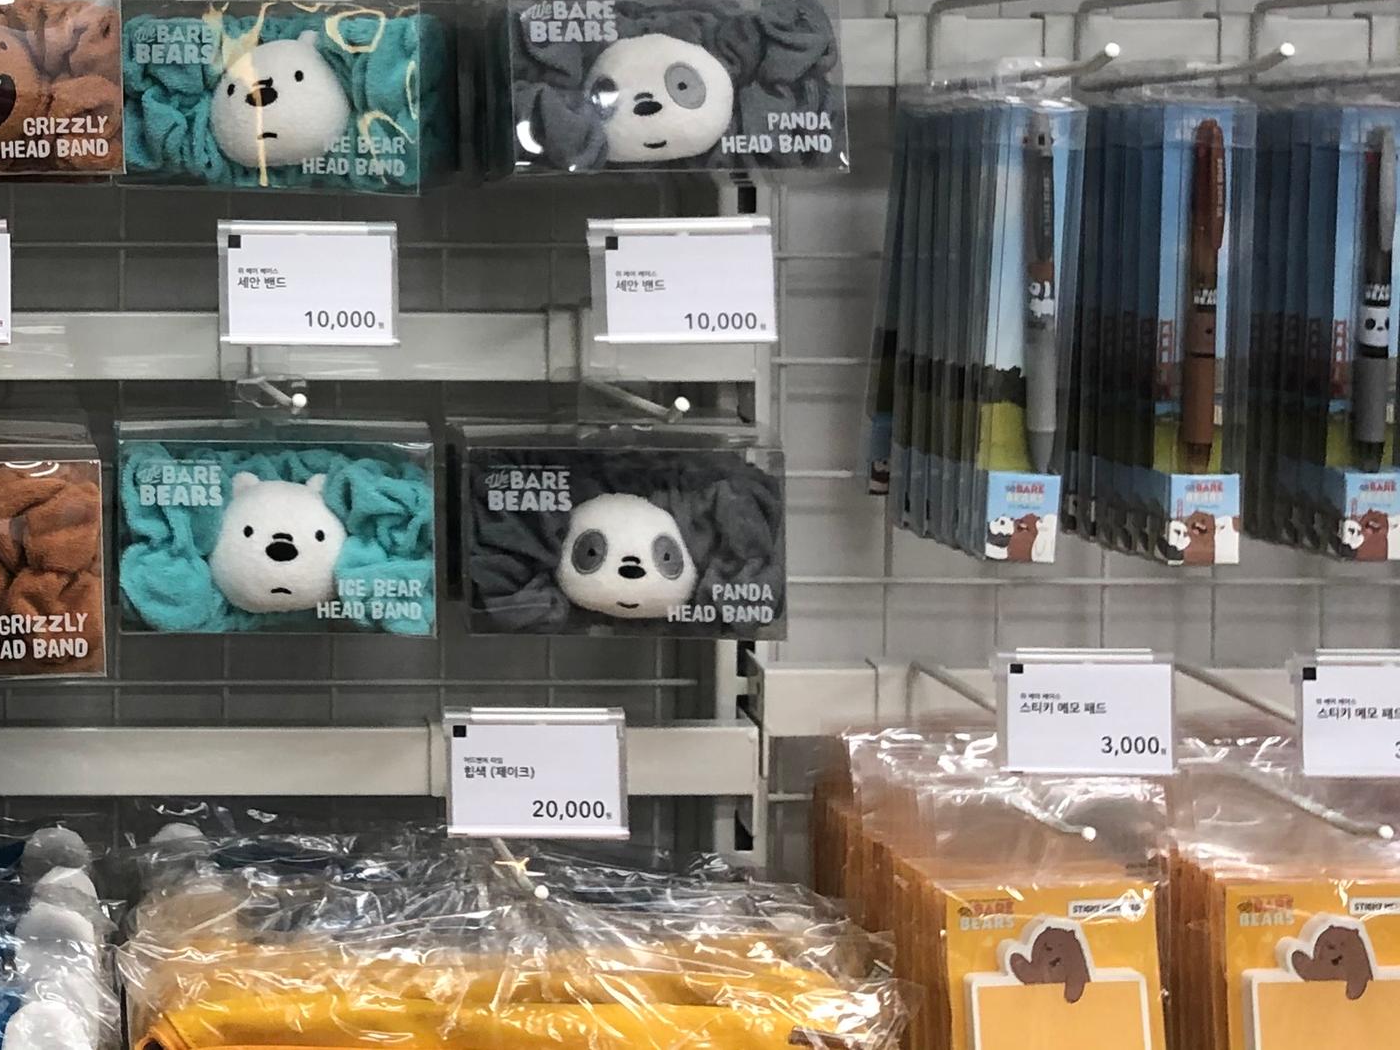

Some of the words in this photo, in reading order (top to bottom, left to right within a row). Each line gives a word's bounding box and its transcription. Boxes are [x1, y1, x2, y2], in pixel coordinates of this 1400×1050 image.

[552, 0, 615, 20] BARE
[530, 20, 618, 42] BEARS
[135, 45, 214, 64] BEARS
[23, 115, 108, 136] GRIZZLY
[768, 112, 832, 130] PANDA
[1, 140, 50, 159] HEAD
[56, 138, 109, 158] BAND
[357, 137, 406, 154] BEAR
[722, 136, 772, 154] HEAD
[779, 135, 832, 153] BAND
[302, 158, 349, 175] HEAD
[355, 158, 405, 176] BAND
[238, 276, 260, 289] 세안
[264, 276, 287, 289] 밴드
[616, 279, 638, 292] 세안
[642, 279, 666, 292] 밴드
[162, 465, 221, 485] BARE
[510, 471, 570, 491] BARE
[139, 485, 223, 506] BEARS
[488, 490, 572, 512] BEARS
[338, 579, 366, 597] ICE
[372, 578, 422, 597] BEAR
[712, 584, 773, 601] PANDA
[317, 602, 365, 620] HEAD
[371, 601, 421, 620] BAND
[667, 605, 716, 623] HEAD
[722, 605, 773, 623] BAND
[33, 638, 88, 659] BAND
[1020, 702, 1053, 714] 스티키
[1317, 707, 1351, 719] 스티키
